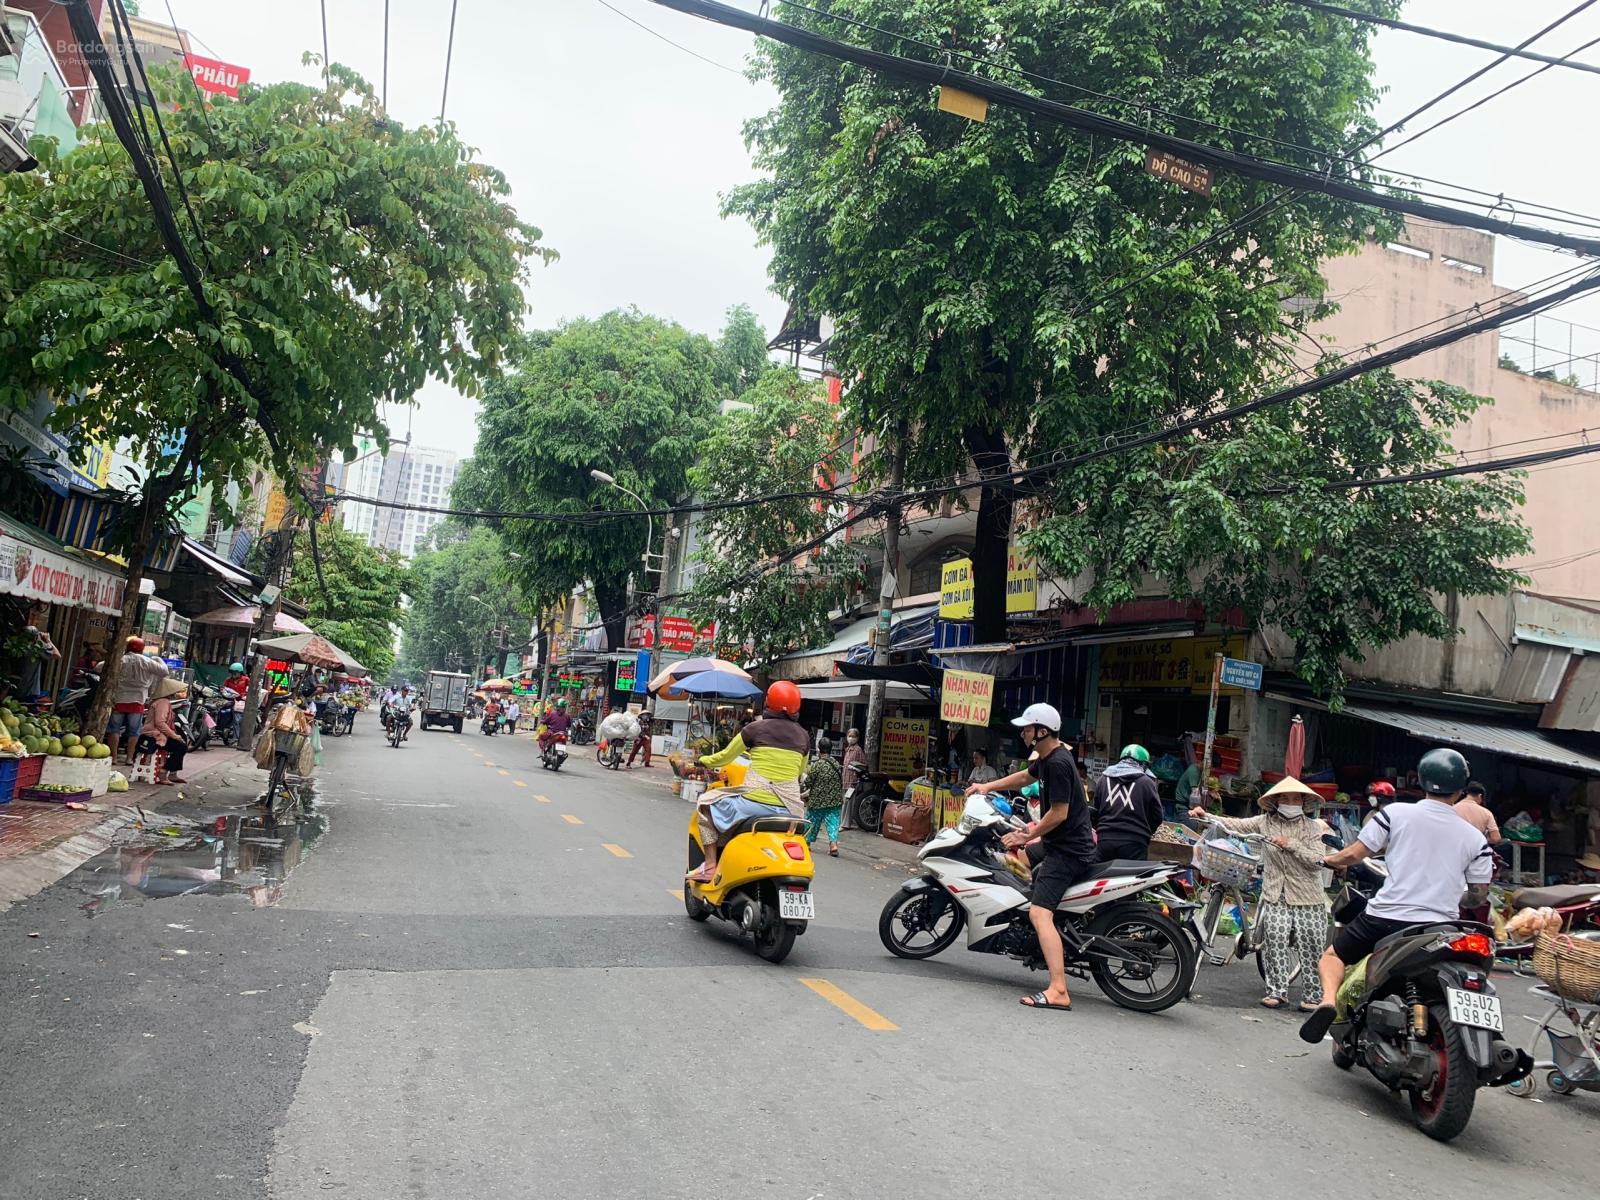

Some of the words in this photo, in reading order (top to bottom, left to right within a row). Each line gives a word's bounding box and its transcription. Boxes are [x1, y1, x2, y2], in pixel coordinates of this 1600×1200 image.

[1170, 166, 1191, 184] CAO
[945, 675, 970, 696] NHẬN
[971, 676, 989, 697] SỬA
[943, 697, 970, 720] QUẦN
[973, 701, 987, 722] ÁO
[785, 893, 808, 905] 59-KA
[1453, 1006, 1501, 1030] 198.92
